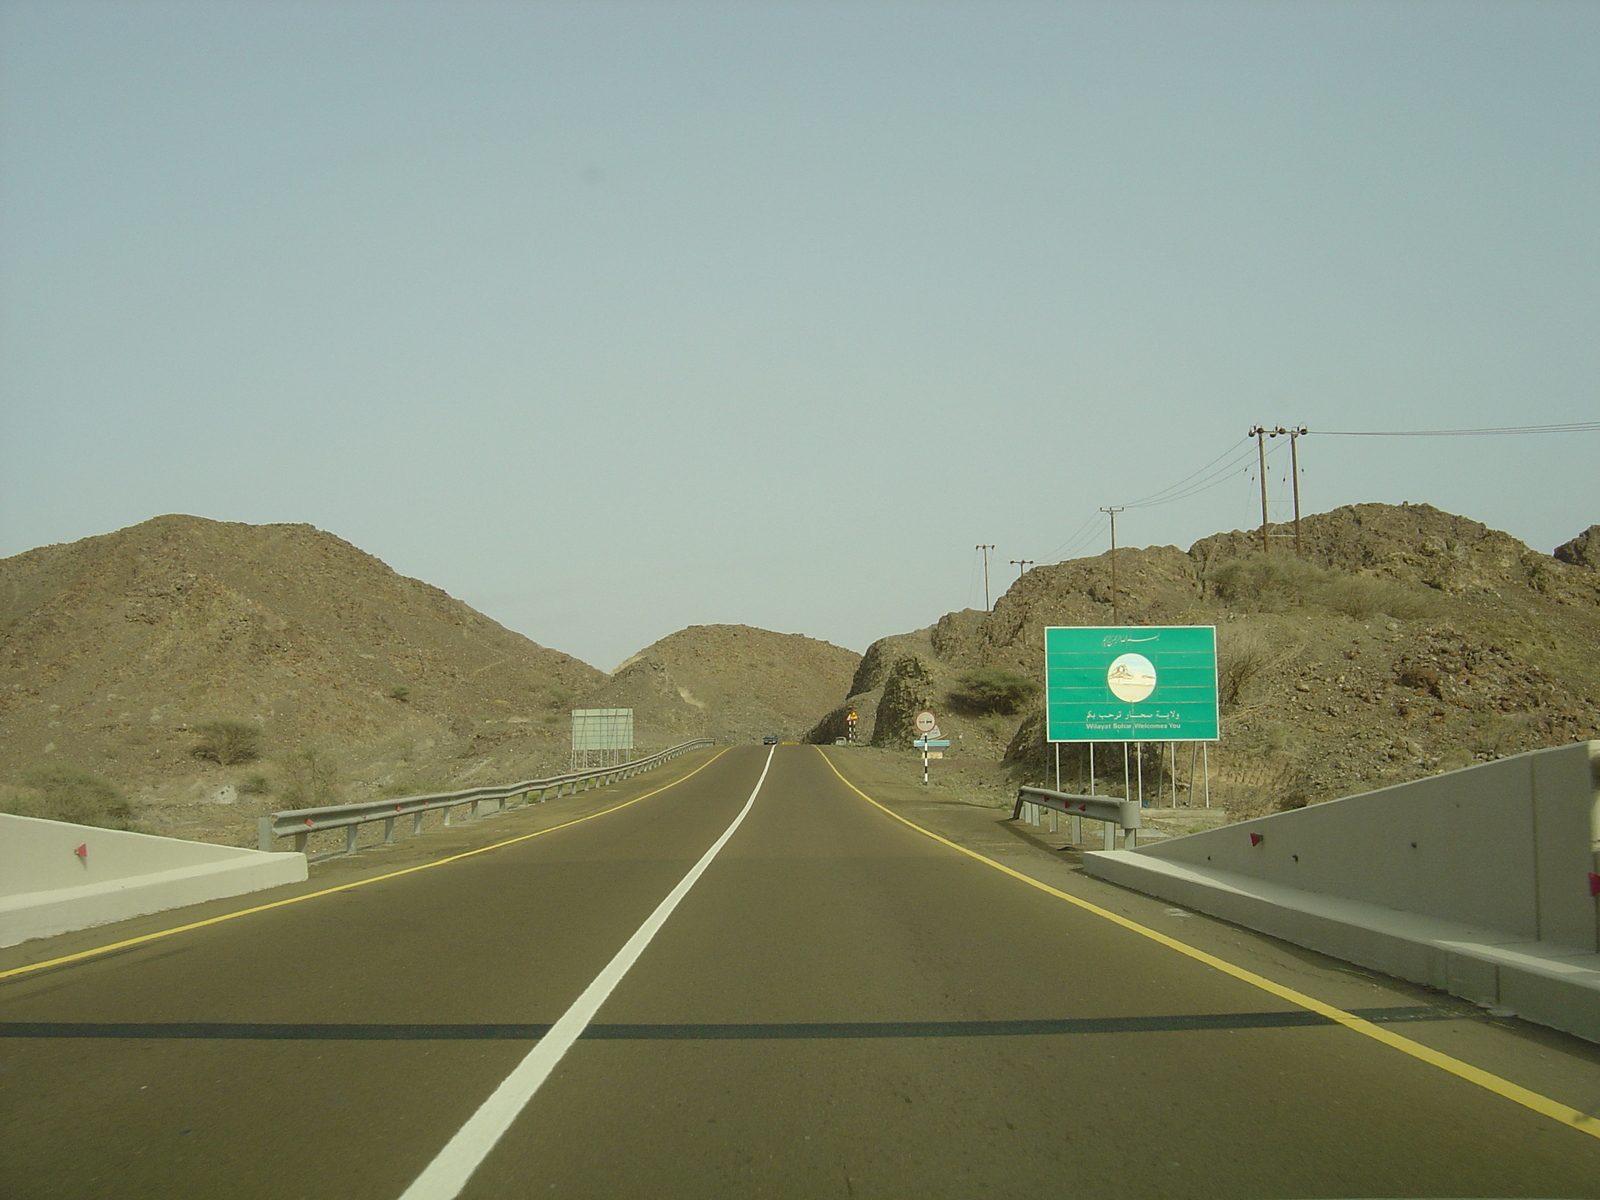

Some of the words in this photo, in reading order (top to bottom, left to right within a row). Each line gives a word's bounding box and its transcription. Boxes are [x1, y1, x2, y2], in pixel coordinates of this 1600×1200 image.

[1086, 710, 1096, 721] بكم
[1099, 710, 1122, 720] ترحب
[1125, 710, 1153, 720] صحار
[1156, 710, 1180, 720] ولاية
